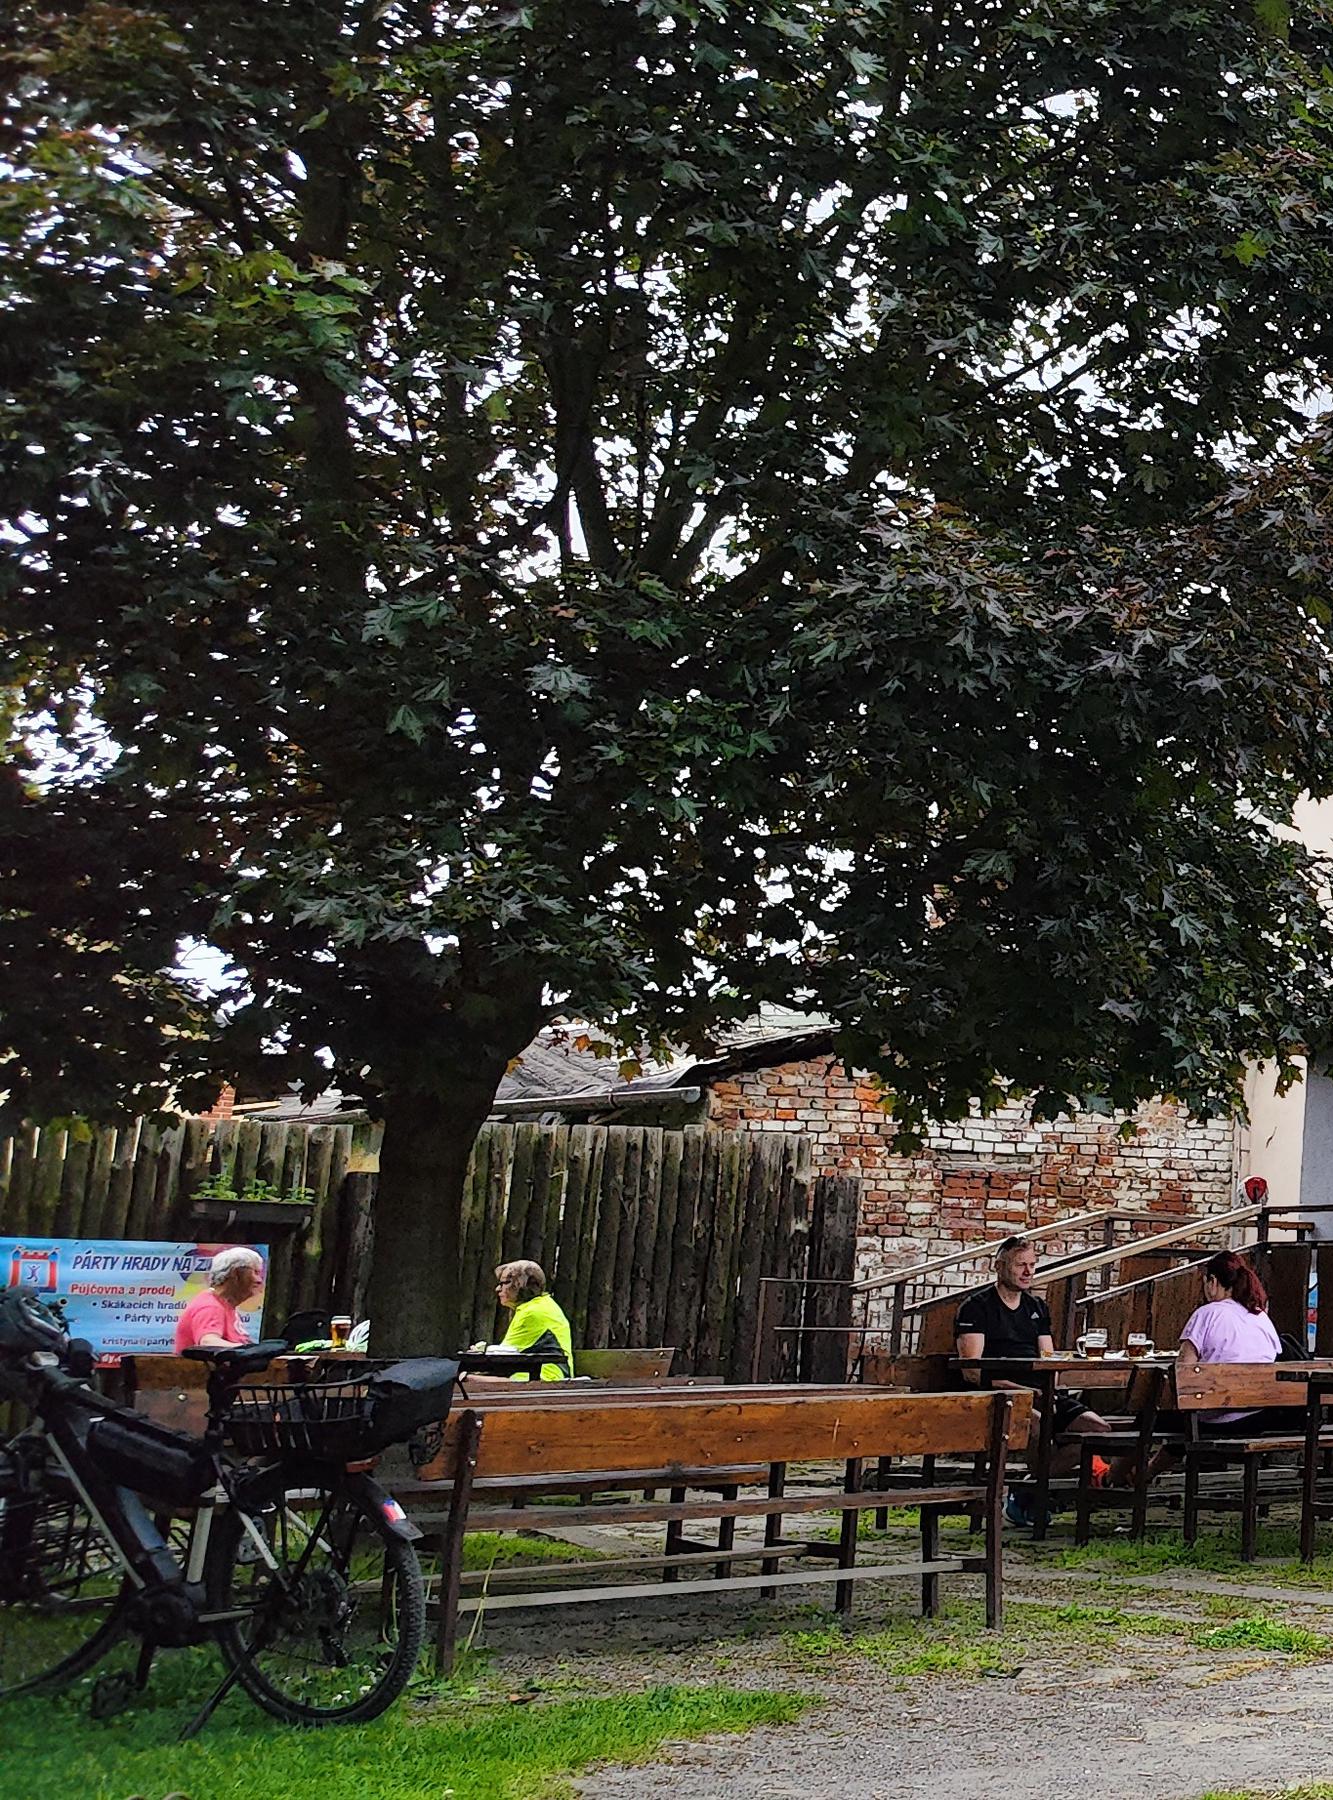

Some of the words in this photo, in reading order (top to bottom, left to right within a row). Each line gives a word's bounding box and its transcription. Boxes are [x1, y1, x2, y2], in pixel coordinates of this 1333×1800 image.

[72, 1250, 119, 1270] PÁRTY
[121, 1256, 171, 1271] HRADY
[172, 1257, 192, 1271] NA
[128, 1287, 135, 1295] a
[139, 1285, 176, 1297] prodej
[124, 1313, 151, 1324] Párty
[155, 1314, 179, 1324] vyba
